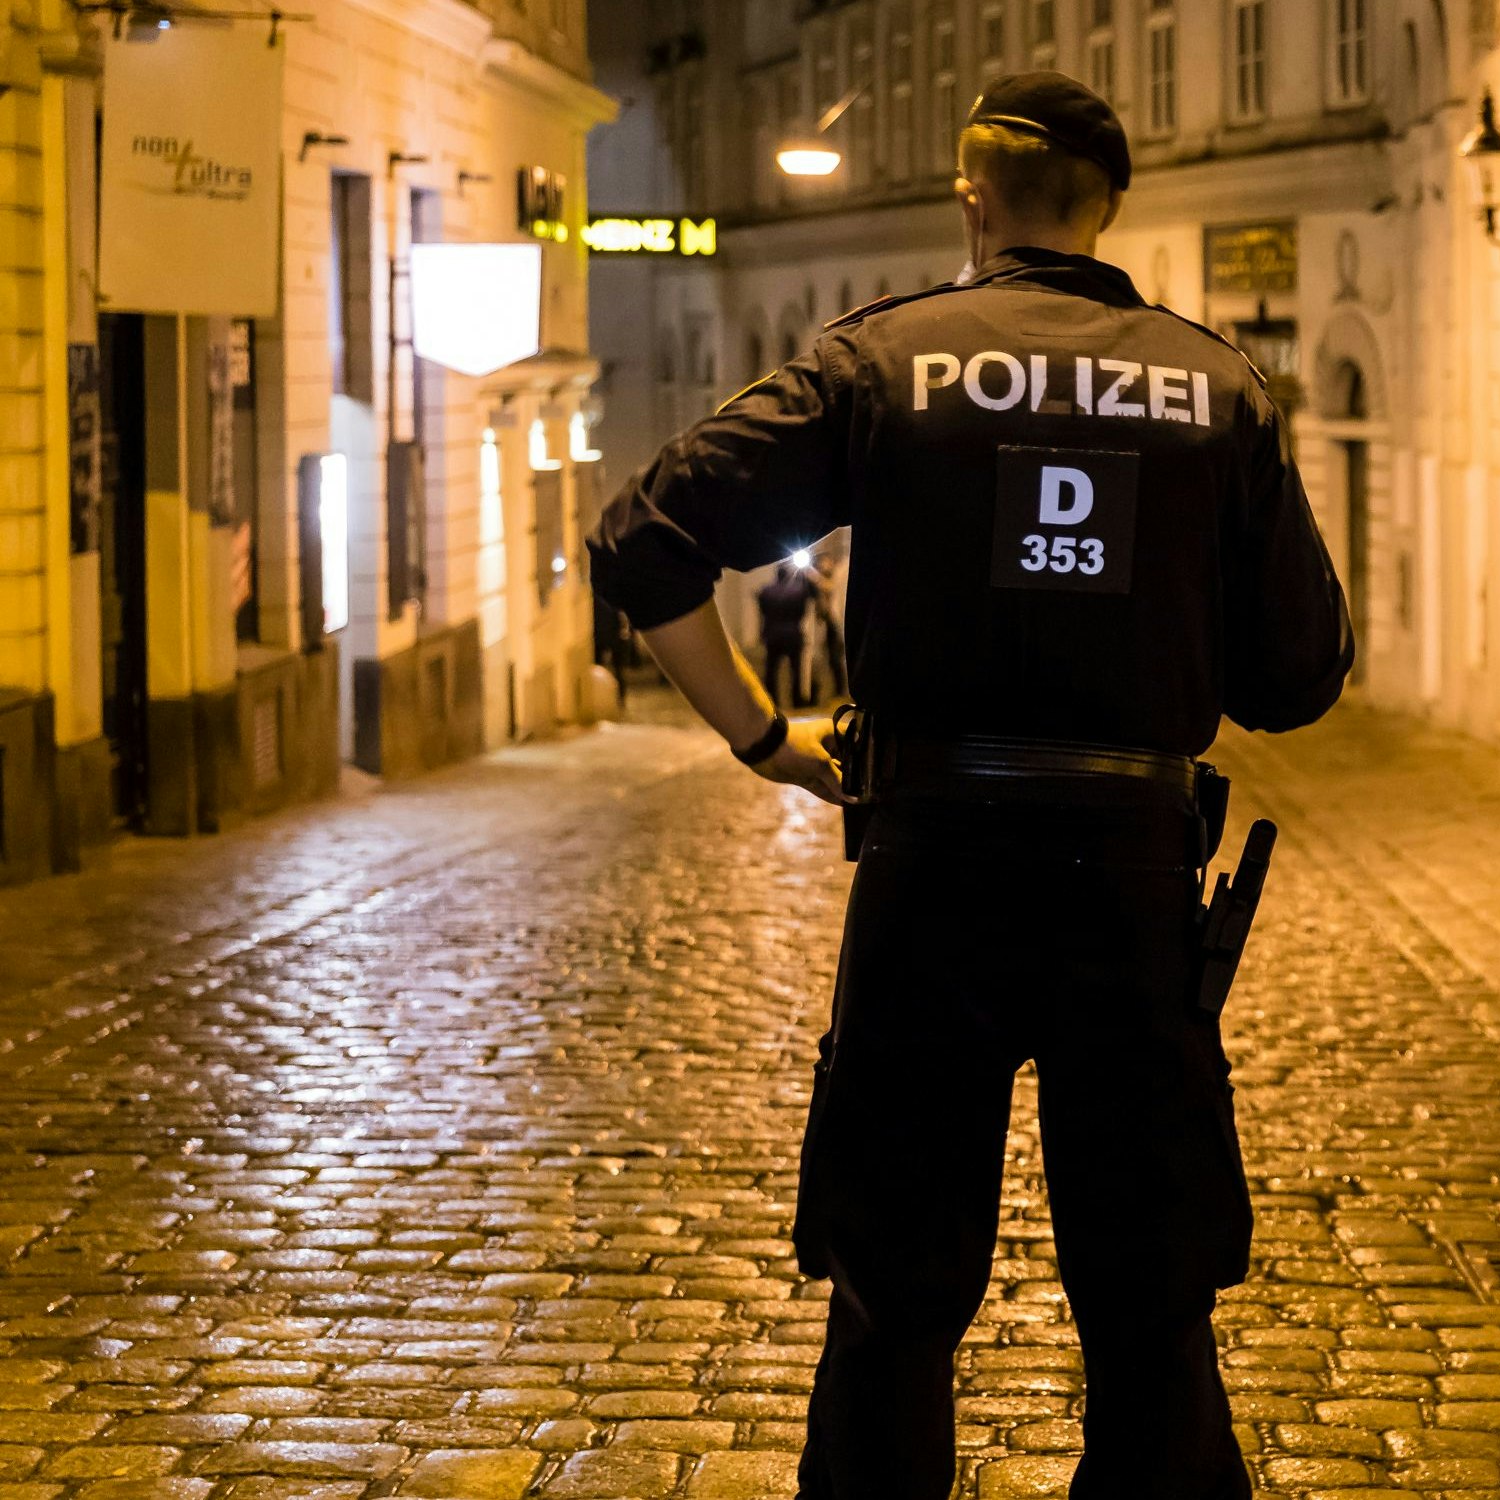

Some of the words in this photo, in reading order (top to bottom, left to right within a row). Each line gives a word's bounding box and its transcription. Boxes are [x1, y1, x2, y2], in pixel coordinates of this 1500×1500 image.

[132, 136, 178, 156] non
[191, 160, 252, 188] ultra
[913, 351, 1210, 426] POLIZEI
[1039, 465, 1094, 525] D
[1020, 534, 1105, 575] 353
